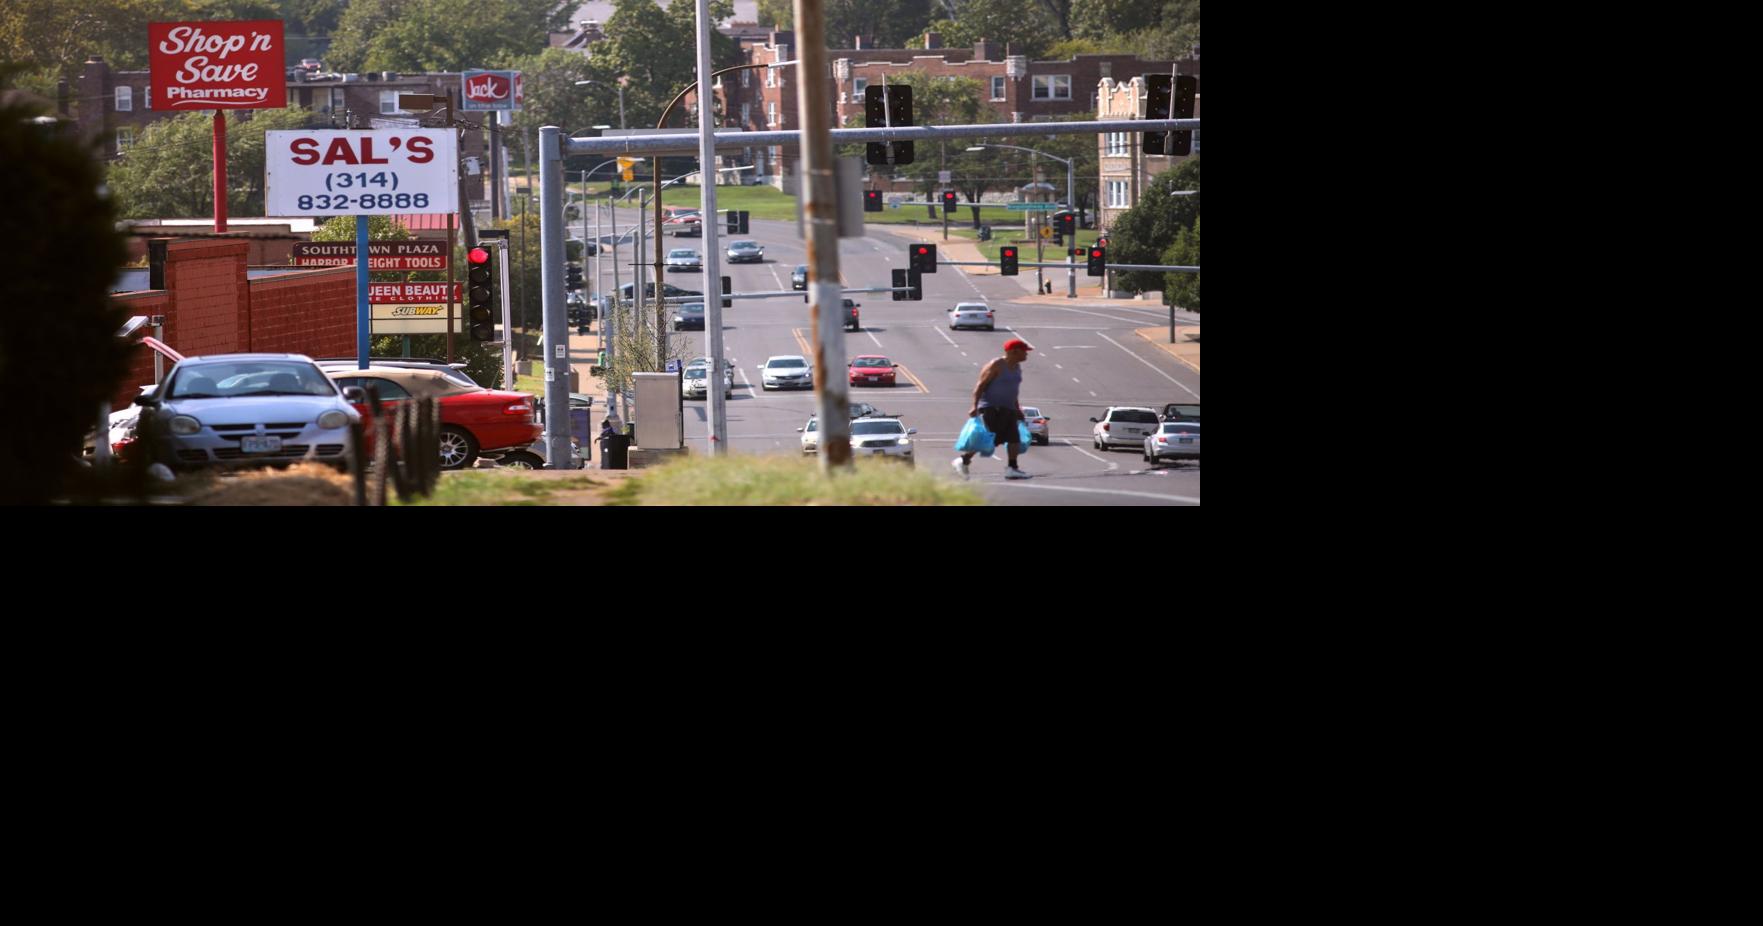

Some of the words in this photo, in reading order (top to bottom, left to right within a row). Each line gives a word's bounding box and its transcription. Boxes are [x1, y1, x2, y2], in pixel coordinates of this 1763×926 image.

[175, 56, 259, 84] Save
[167, 86, 269, 100] Pharmacy
[466, 77, 508, 99] Jack
[290, 136, 434, 165] SAL'S
[325, 171, 399, 192] (314)
[297, 193, 429, 211] 832-8888
[302, 245, 390, 255] SOUTHTWN
[398, 244, 439, 254] PLAZA
[405, 257, 441, 268] TOOLS
[368, 285, 401, 296] UEEN
[393, 305, 443, 316] SUBWAY
